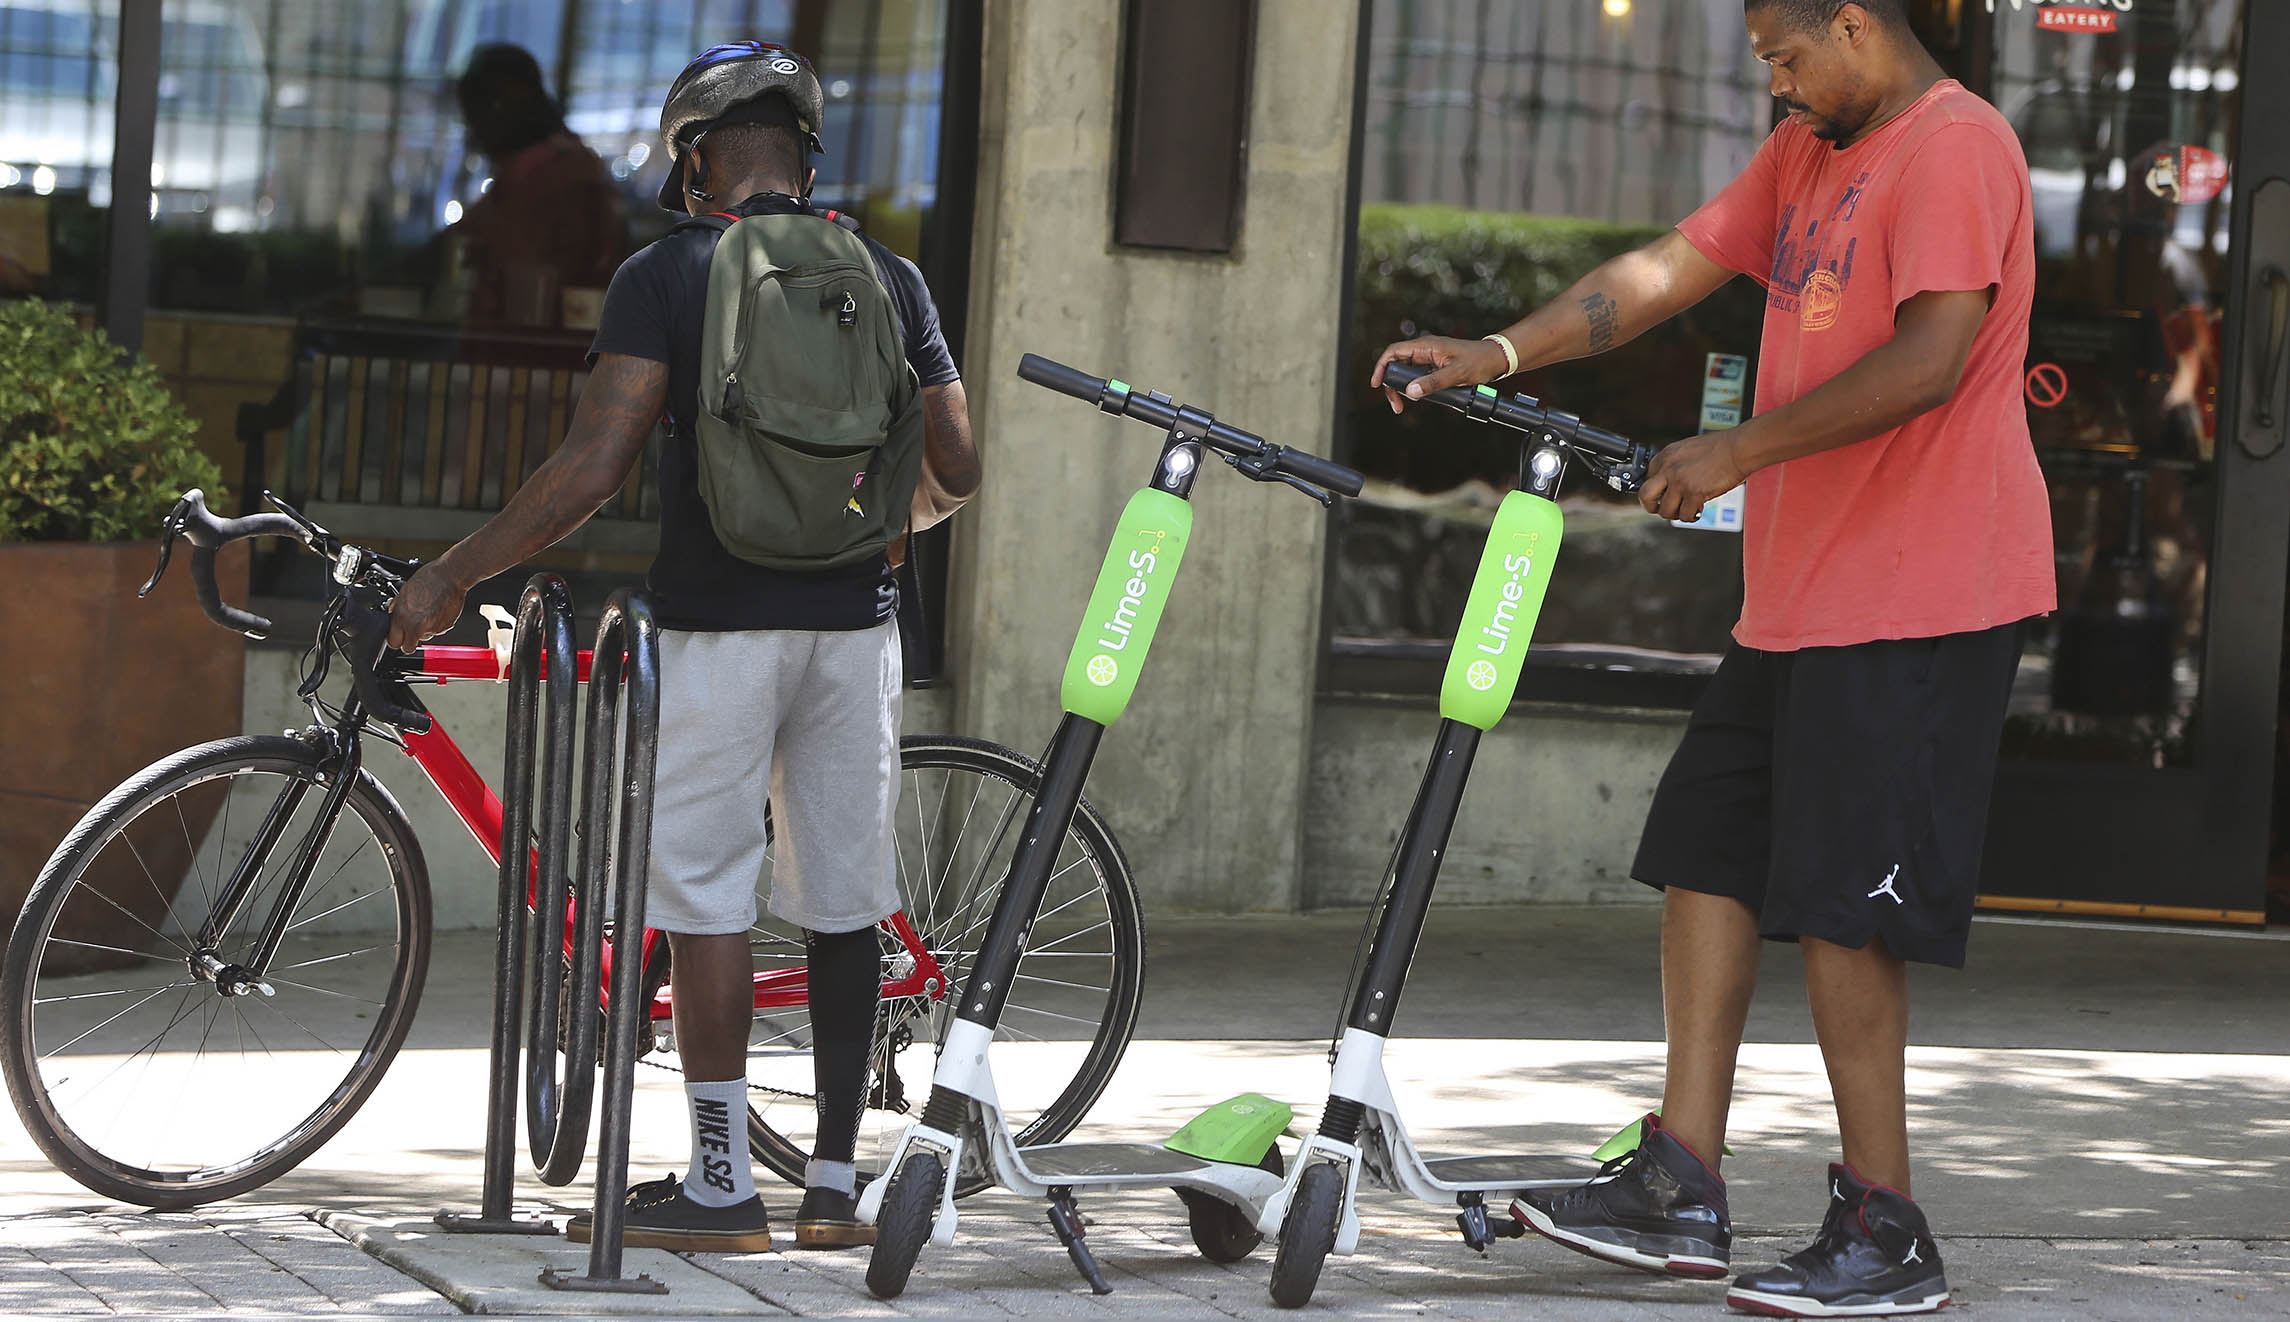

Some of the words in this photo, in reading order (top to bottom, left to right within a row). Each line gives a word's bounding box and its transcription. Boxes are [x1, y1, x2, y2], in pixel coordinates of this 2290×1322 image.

[2043, 11, 2112, 27] EATERY
[694, 1097, 730, 1154] NIKE
[702, 1155, 735, 1193] SB
